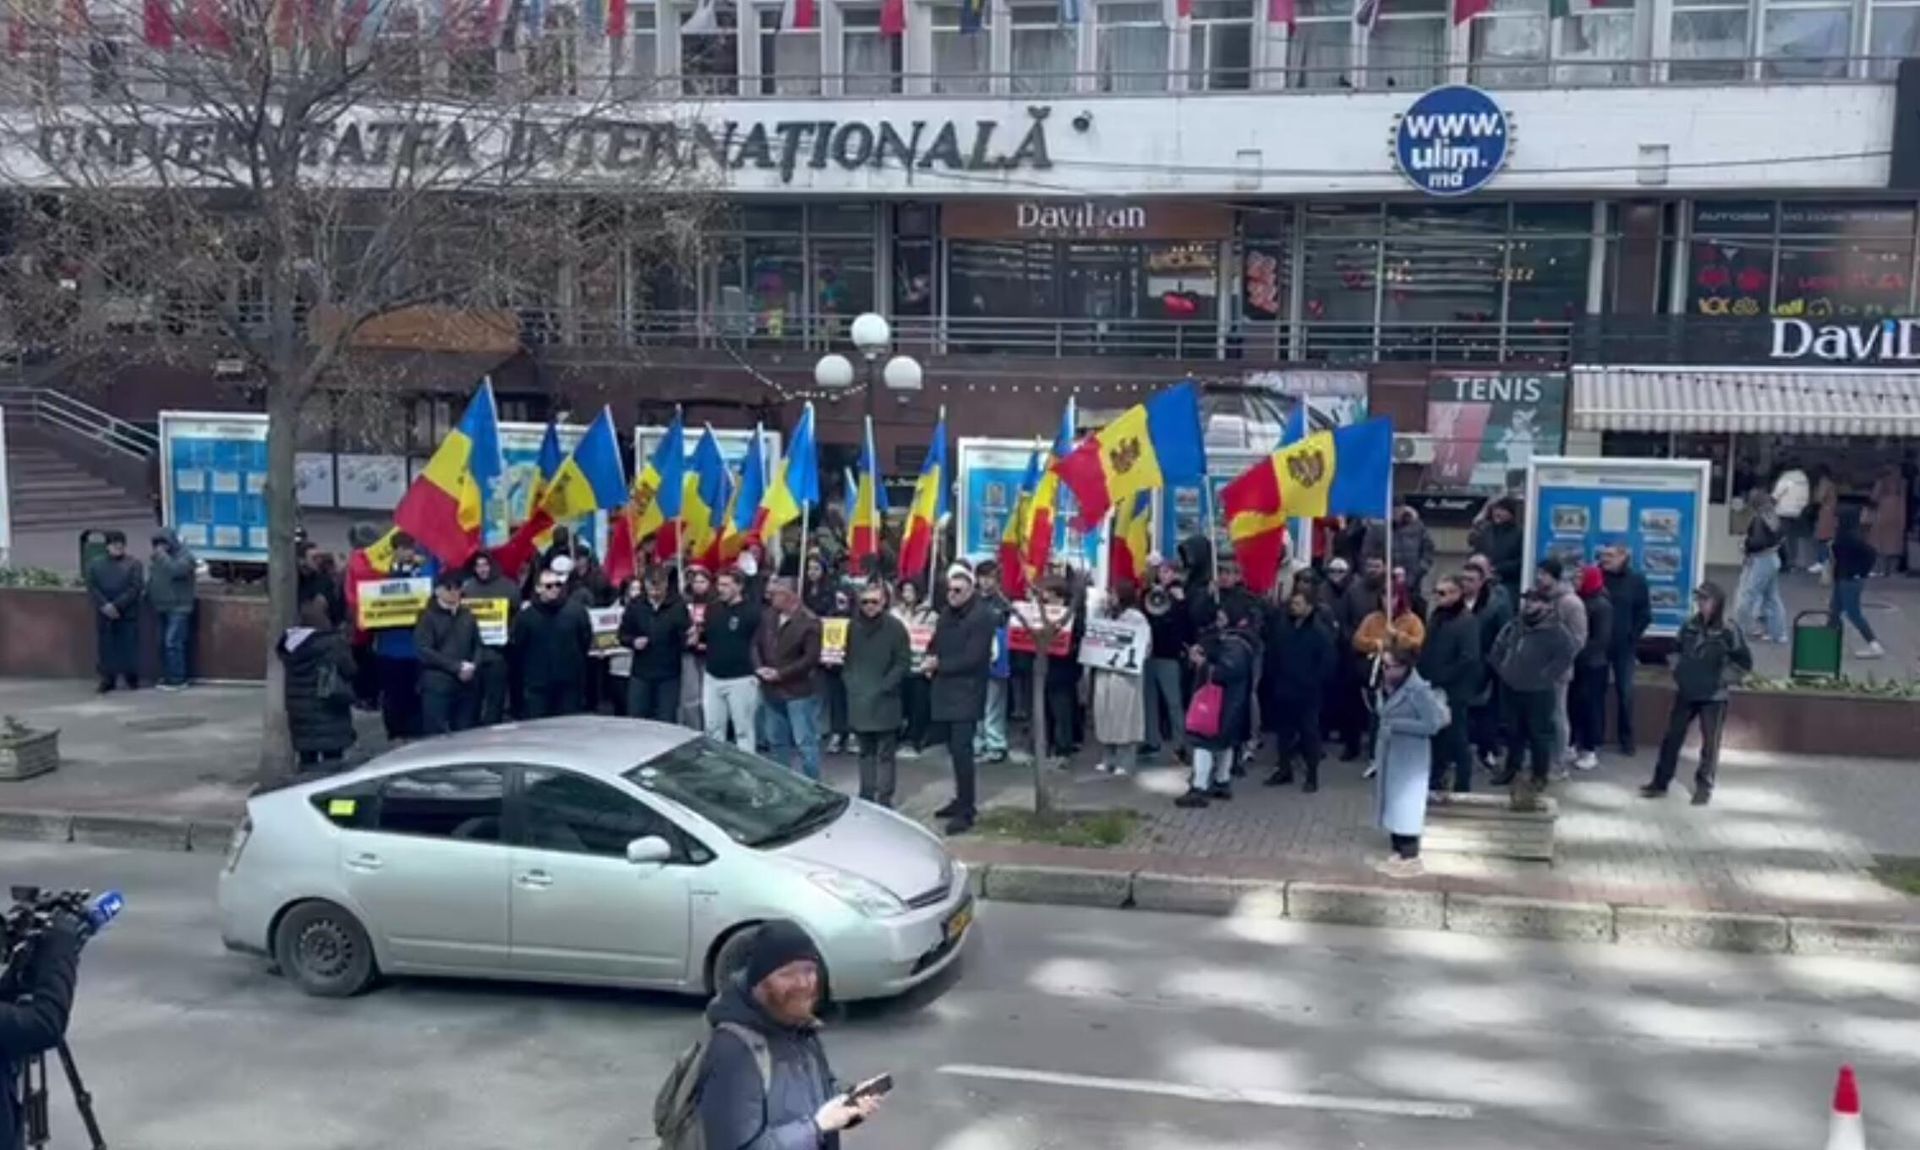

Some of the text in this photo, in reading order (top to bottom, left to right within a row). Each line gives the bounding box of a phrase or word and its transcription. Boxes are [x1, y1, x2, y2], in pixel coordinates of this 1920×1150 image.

[1407, 113, 1502, 138] www.
[40, 122, 481, 167] UNIVERTATEA
[1411, 138, 1488, 169] ulim.
[1453, 377, 1542, 402] TENIS
